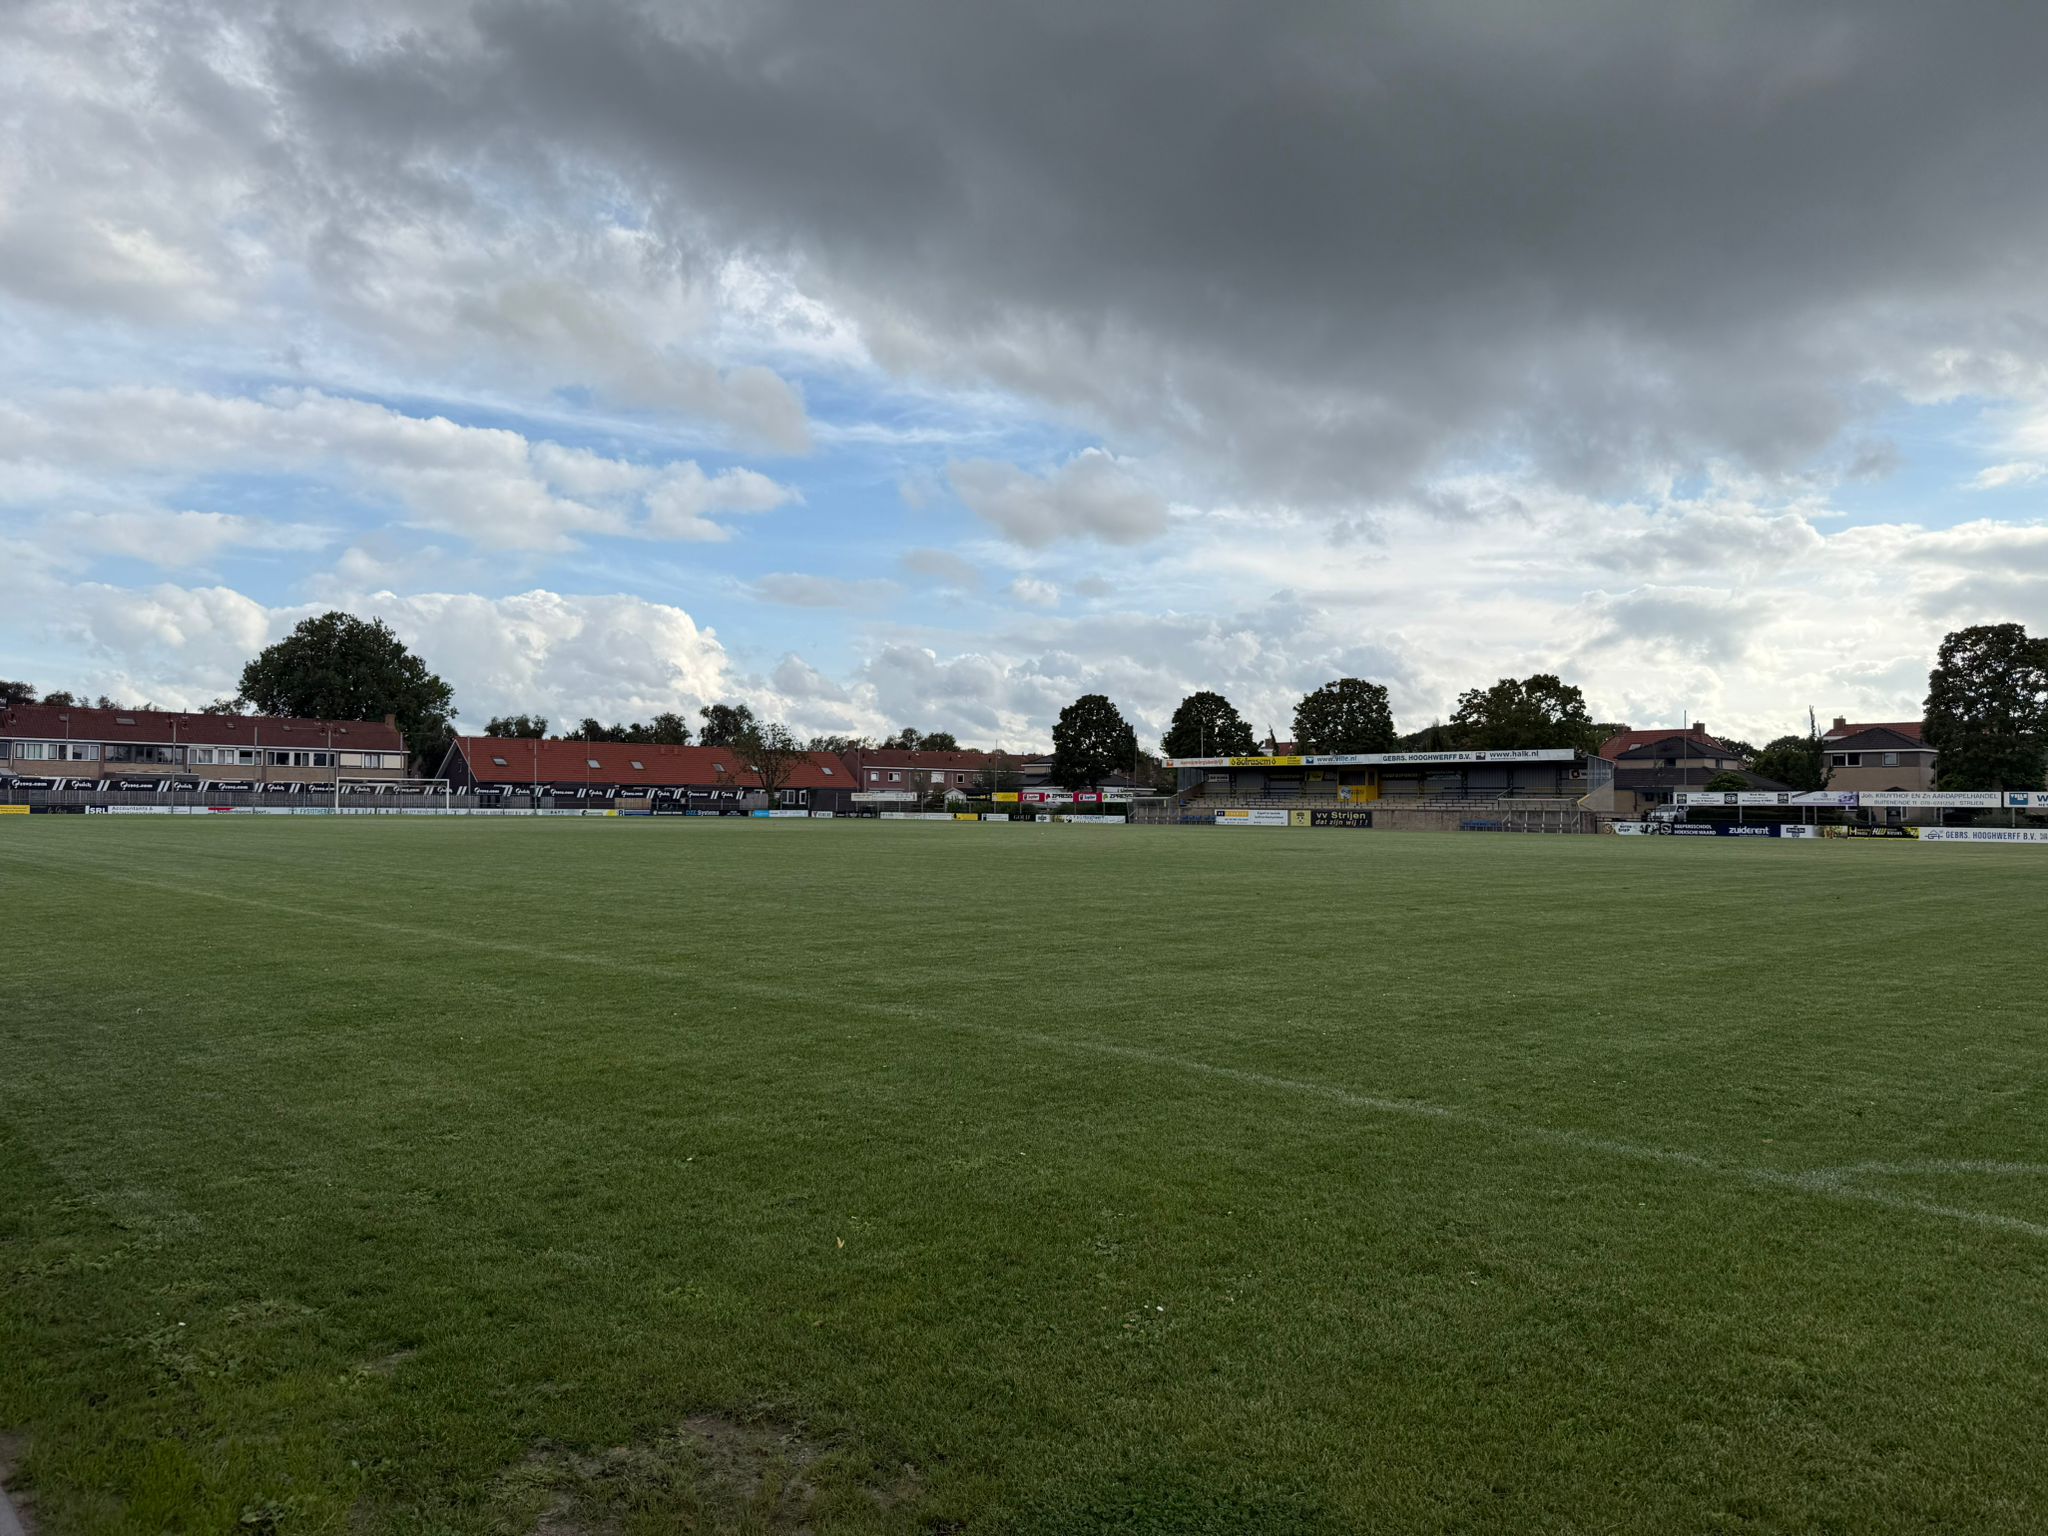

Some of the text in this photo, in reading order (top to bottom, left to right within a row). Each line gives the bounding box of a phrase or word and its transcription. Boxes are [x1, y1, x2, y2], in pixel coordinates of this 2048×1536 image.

[1408, 753, 1457, 761] HOOGHWERFF
[1490, 750, 1539, 758] www.halk.nl
[1330, 811, 1366, 820] Strijen
[1728, 826, 1770, 835] zuiderent
[1972, 832, 2021, 840] HOOGHWERFF
